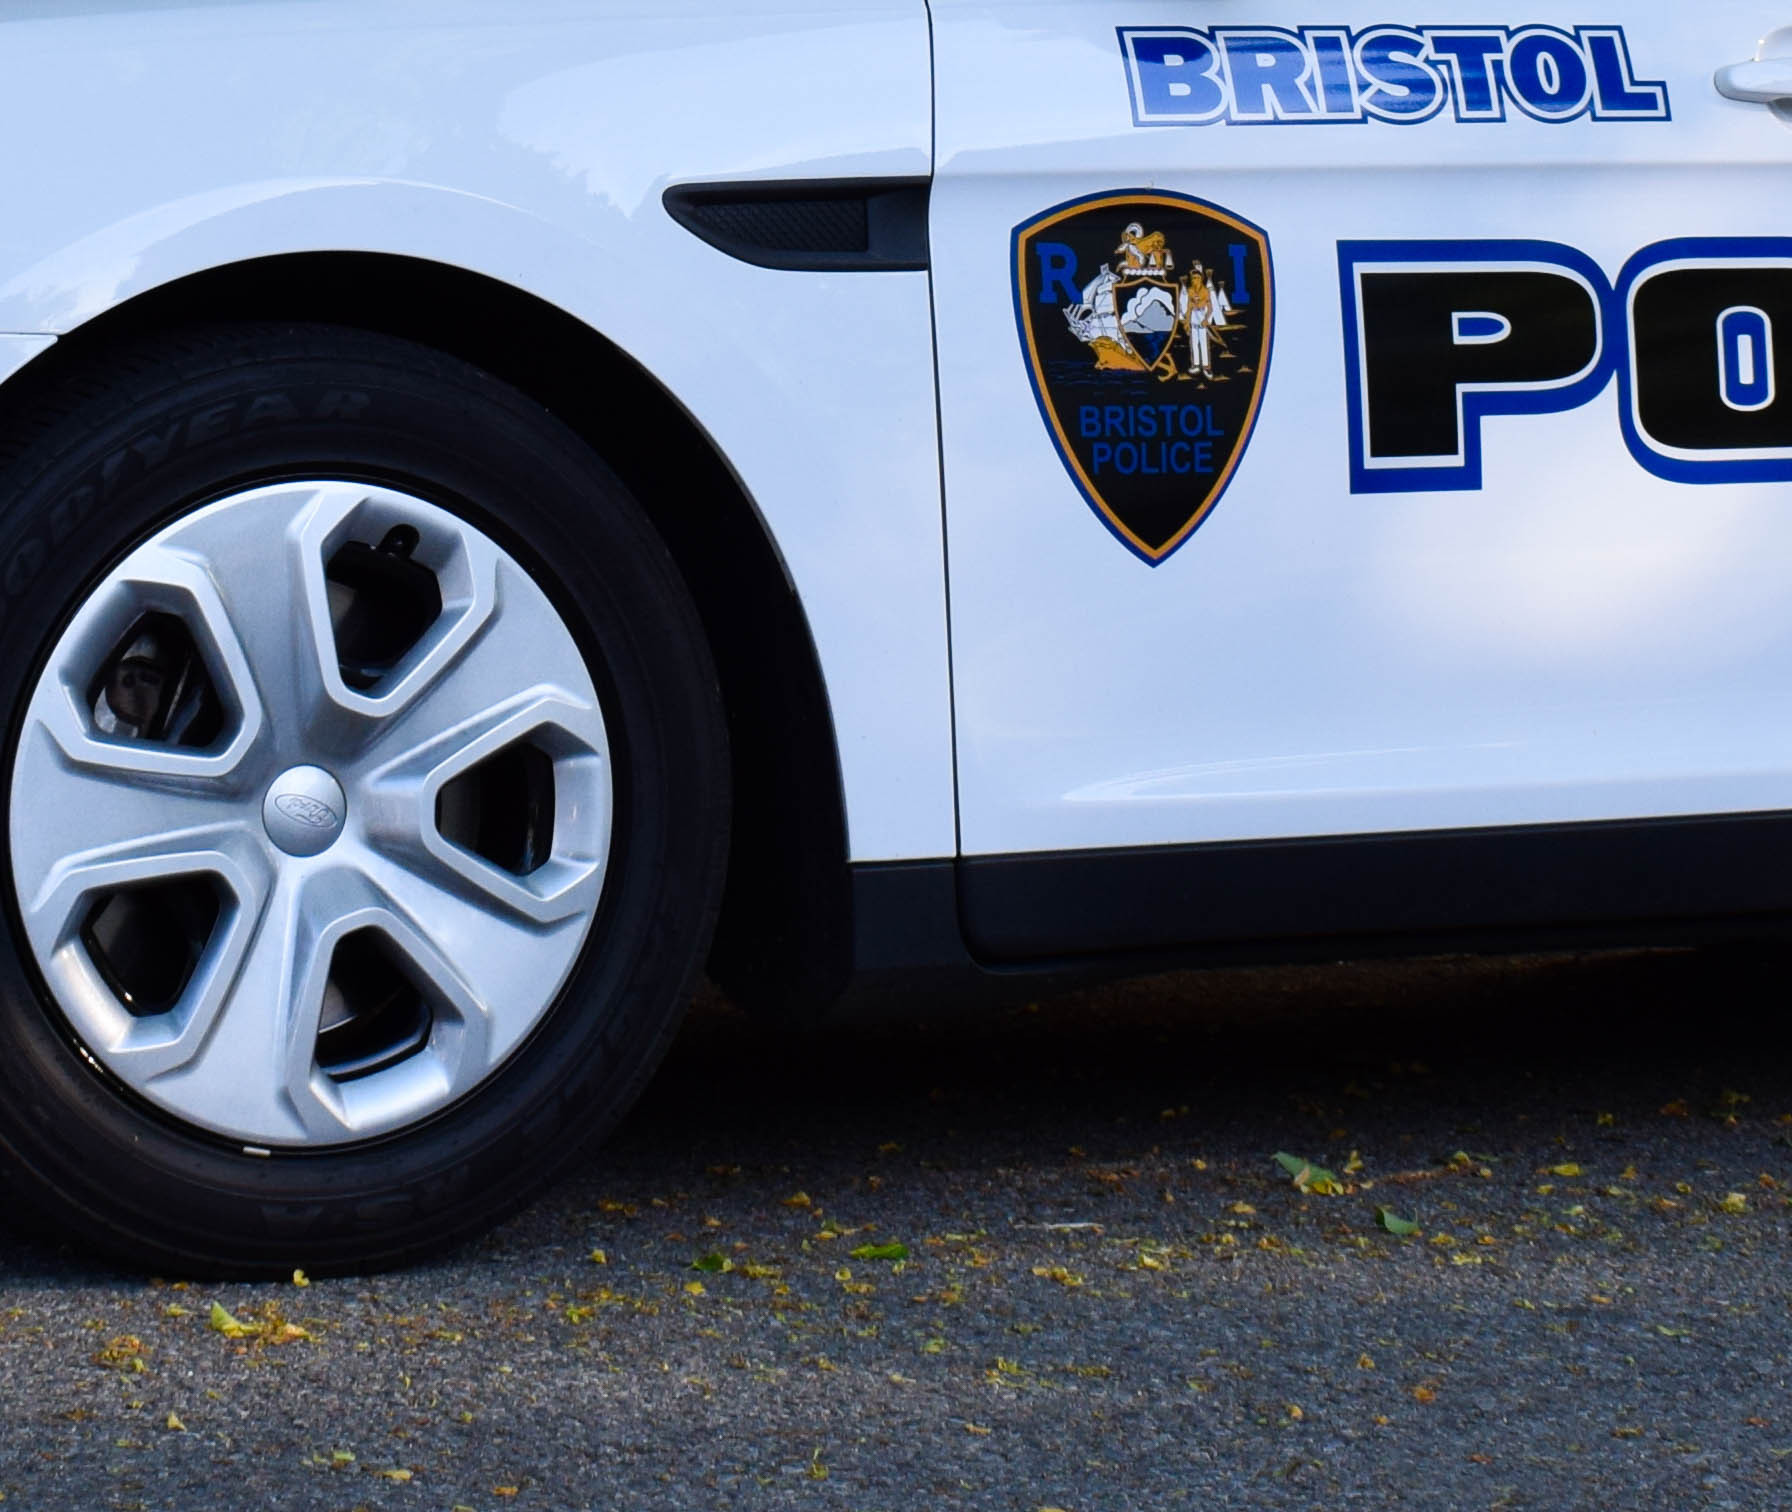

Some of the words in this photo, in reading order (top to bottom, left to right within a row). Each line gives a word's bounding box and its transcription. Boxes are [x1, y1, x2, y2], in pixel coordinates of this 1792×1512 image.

[1116, 25, 1671, 127] BRISTOL
[1035, 242, 1084, 305] R
[1227, 243, 1251, 305] I
[1078, 404, 1225, 438] BRISTOL
[1092, 441, 1214, 475] POLICE
